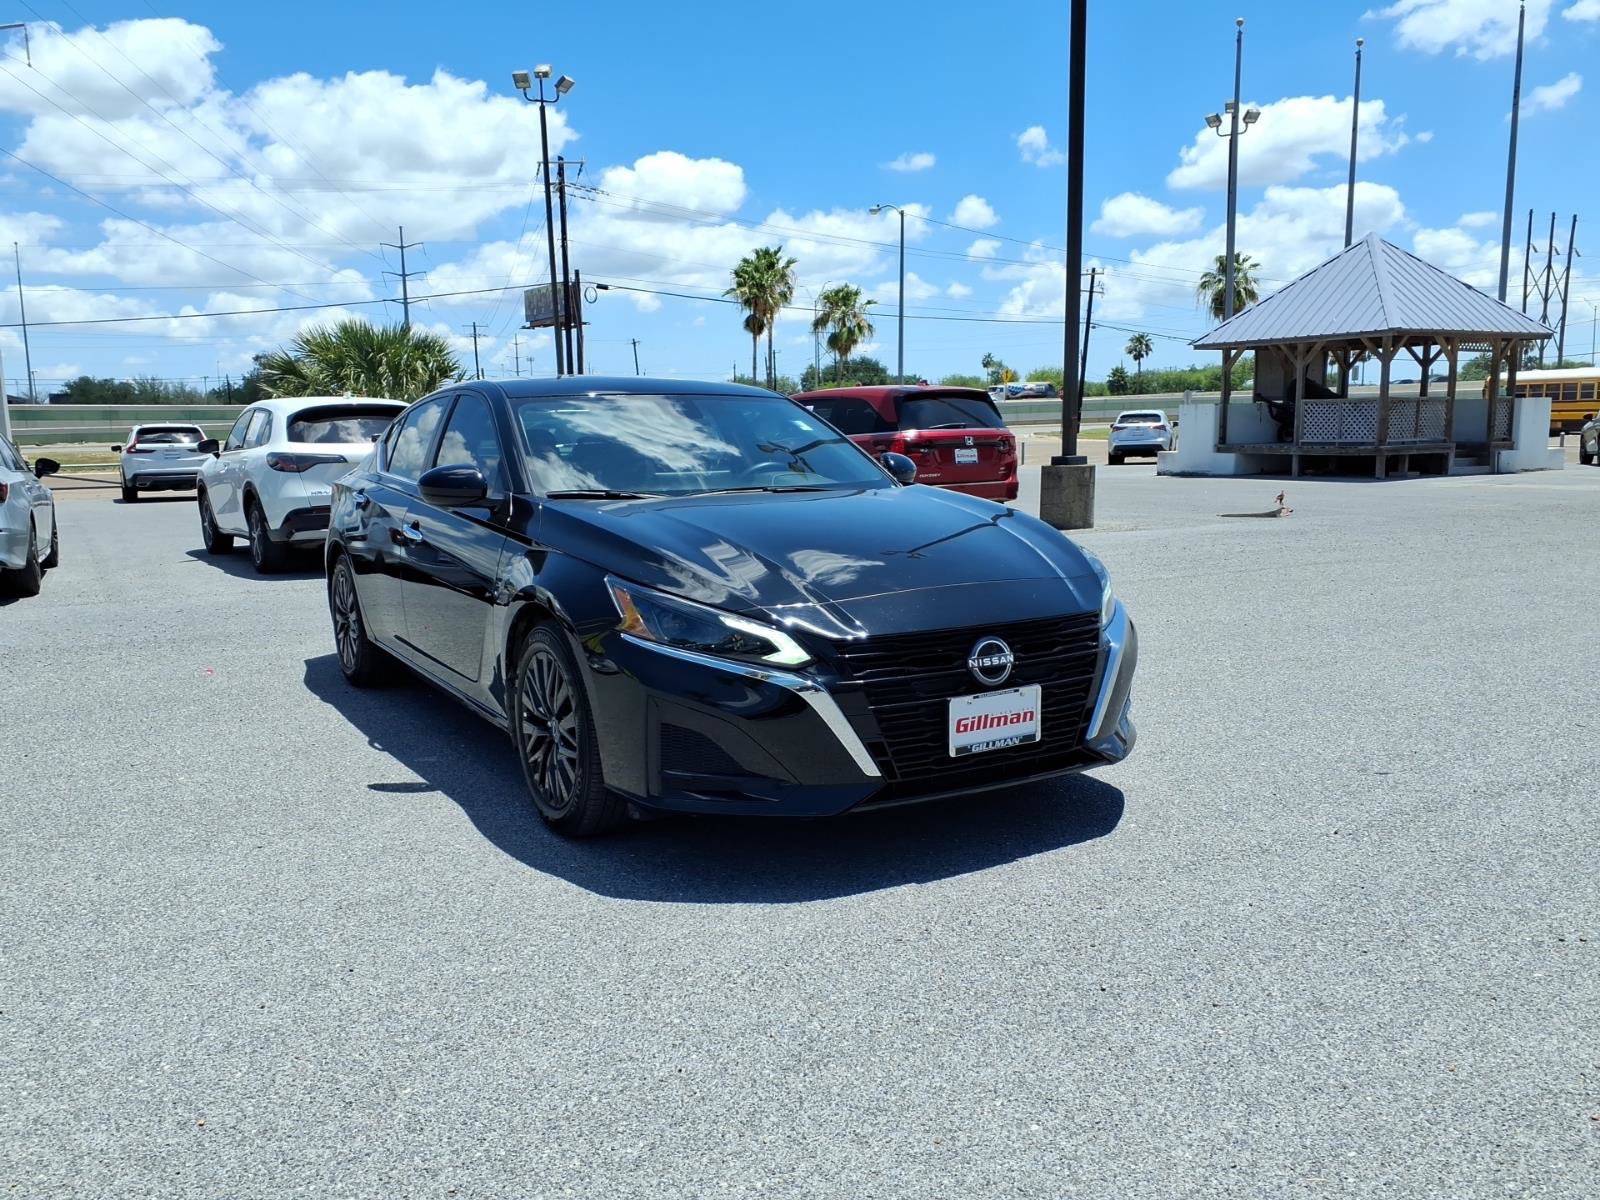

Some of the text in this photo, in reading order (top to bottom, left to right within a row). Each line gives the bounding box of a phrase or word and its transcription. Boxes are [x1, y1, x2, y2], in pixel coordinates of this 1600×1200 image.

[968, 654, 1014, 667] NISSAN
[955, 711, 1035, 733] Gillman
[971, 736, 1020, 752] GILLMAN
